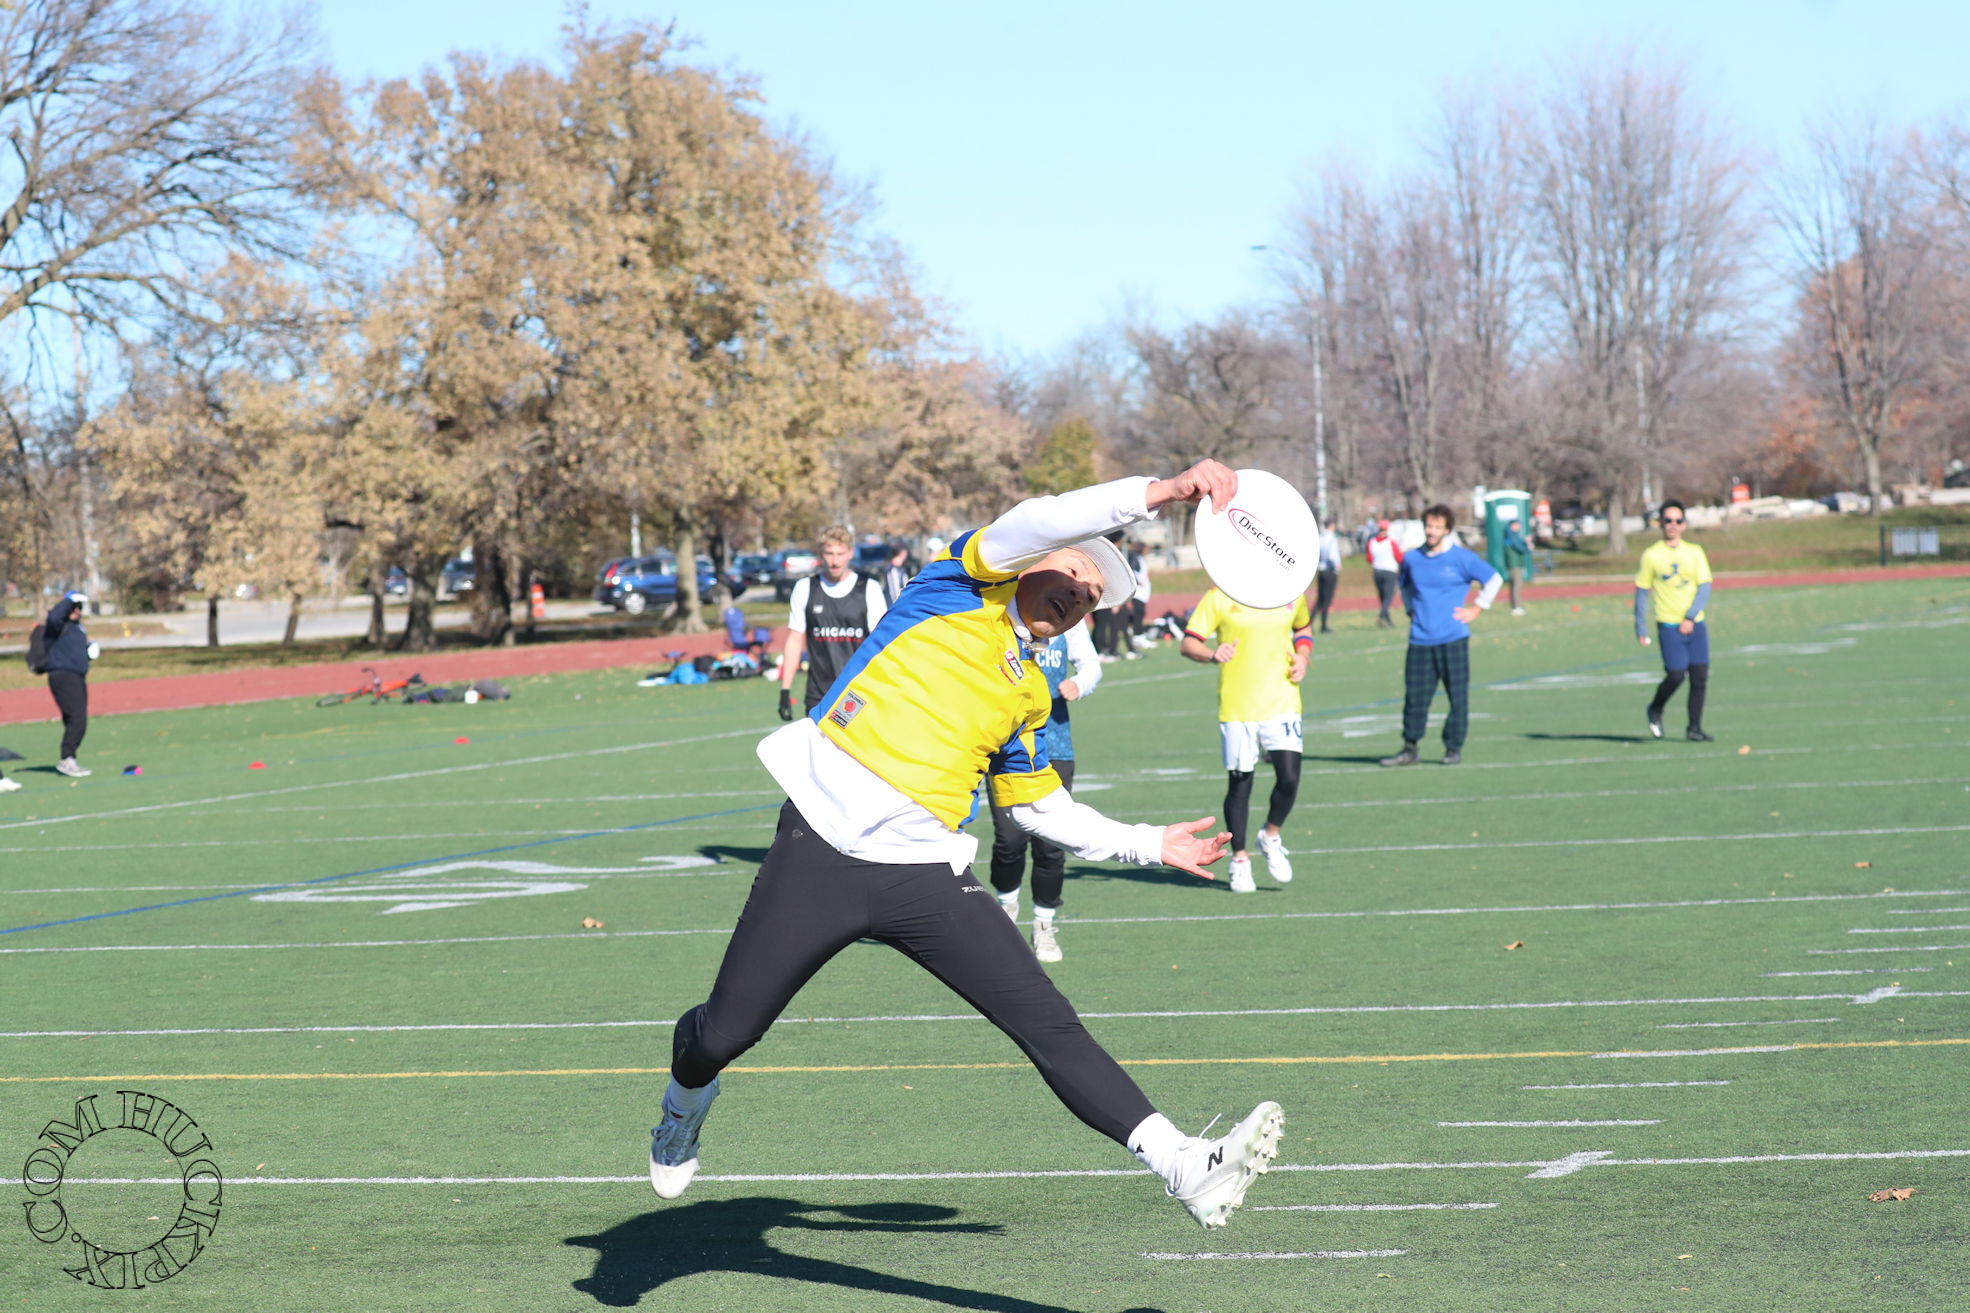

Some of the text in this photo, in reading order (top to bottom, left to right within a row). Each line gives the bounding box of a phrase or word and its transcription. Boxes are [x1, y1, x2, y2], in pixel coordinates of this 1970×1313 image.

[1238, 516, 1296, 567] DiscStore
[813, 626, 863, 638] CHICAGO
[1281, 721, 1302, 738] 10
